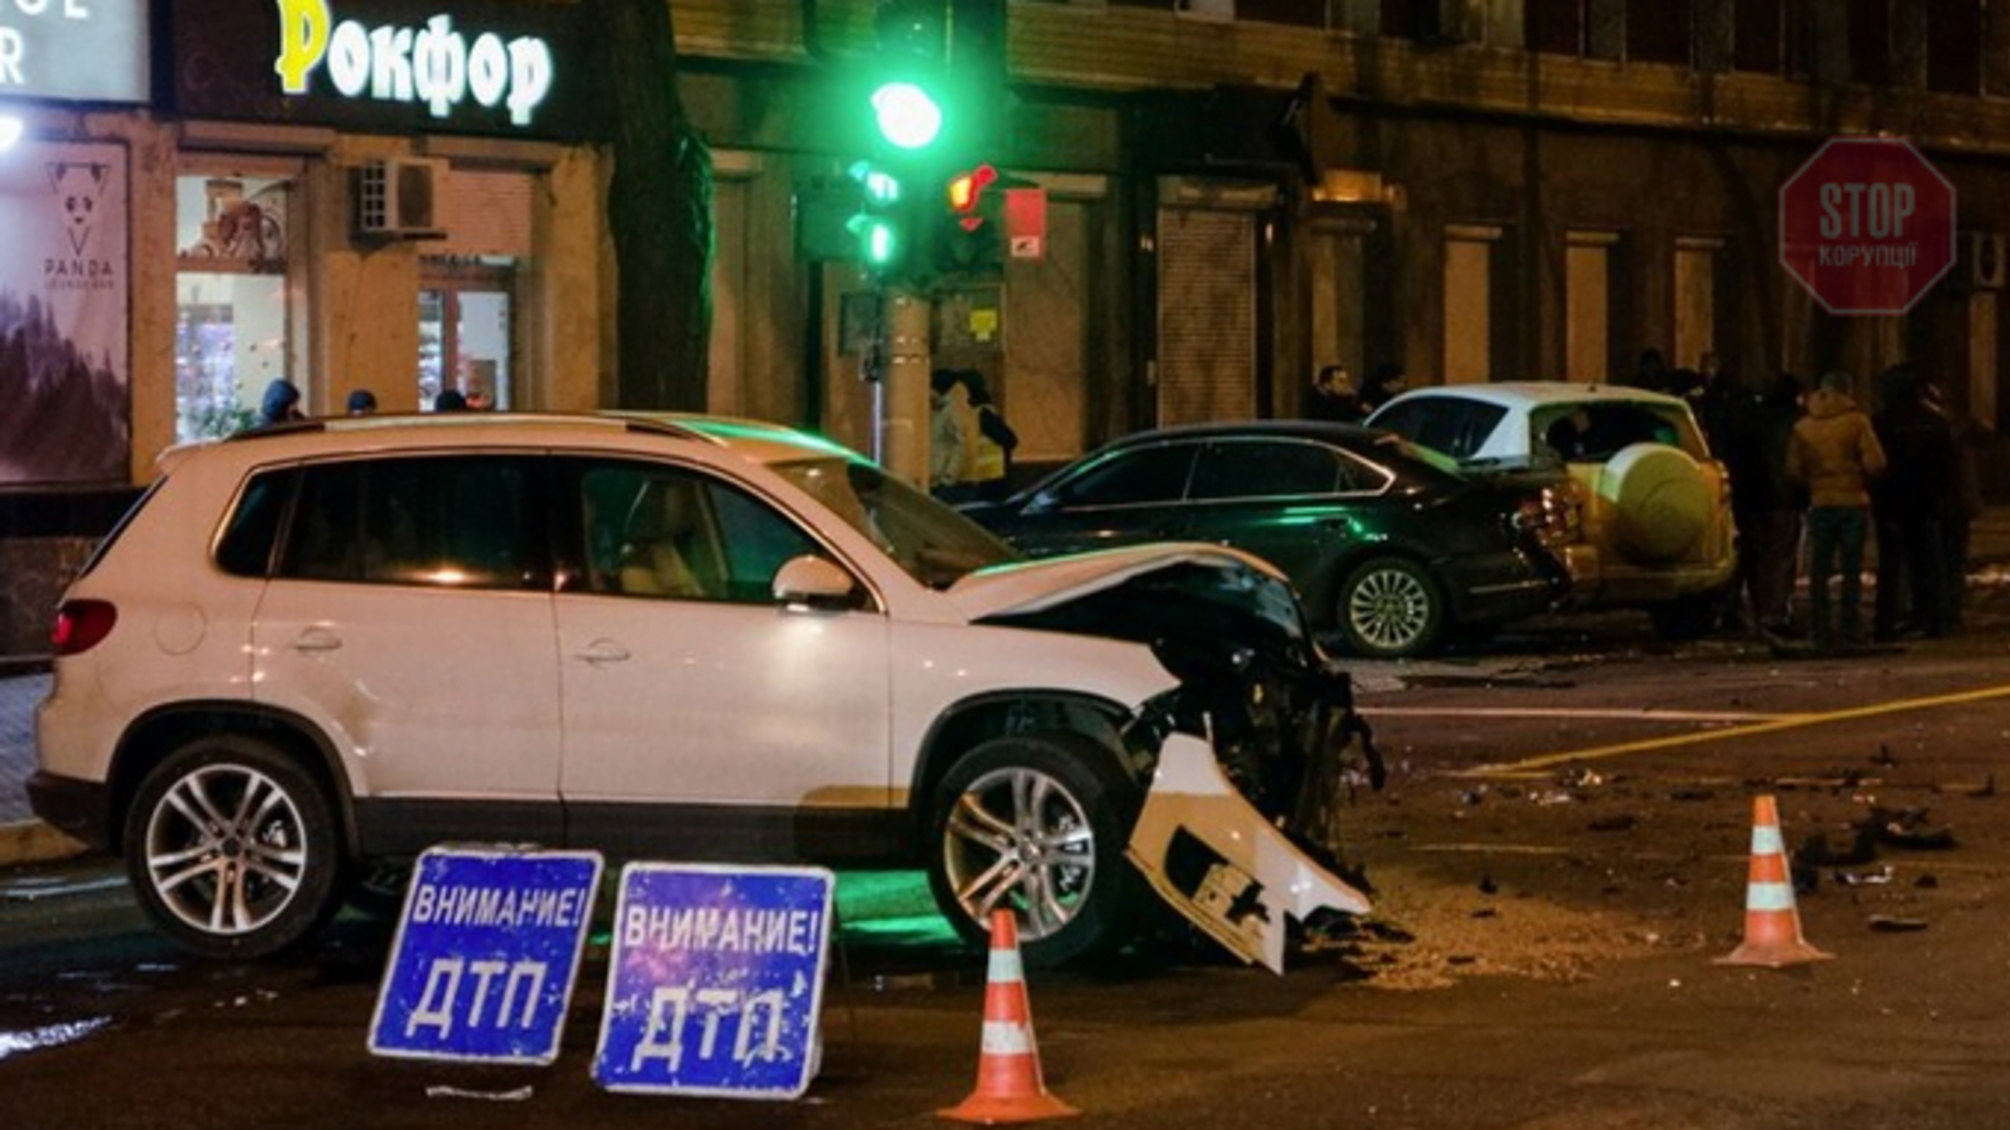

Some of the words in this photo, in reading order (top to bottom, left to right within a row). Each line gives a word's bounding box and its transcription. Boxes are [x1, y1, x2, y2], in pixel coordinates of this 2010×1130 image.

[274, 0, 553, 126] Рокфор
[44, 258, 114, 278] PANDA
[412, 884, 586, 927] ВНИМАНИЕ!
[624, 904, 818, 957] ВНИМАНИЕ!
[404, 957, 548, 1040] ДТП
[630, 986, 784, 1073] ДТП
